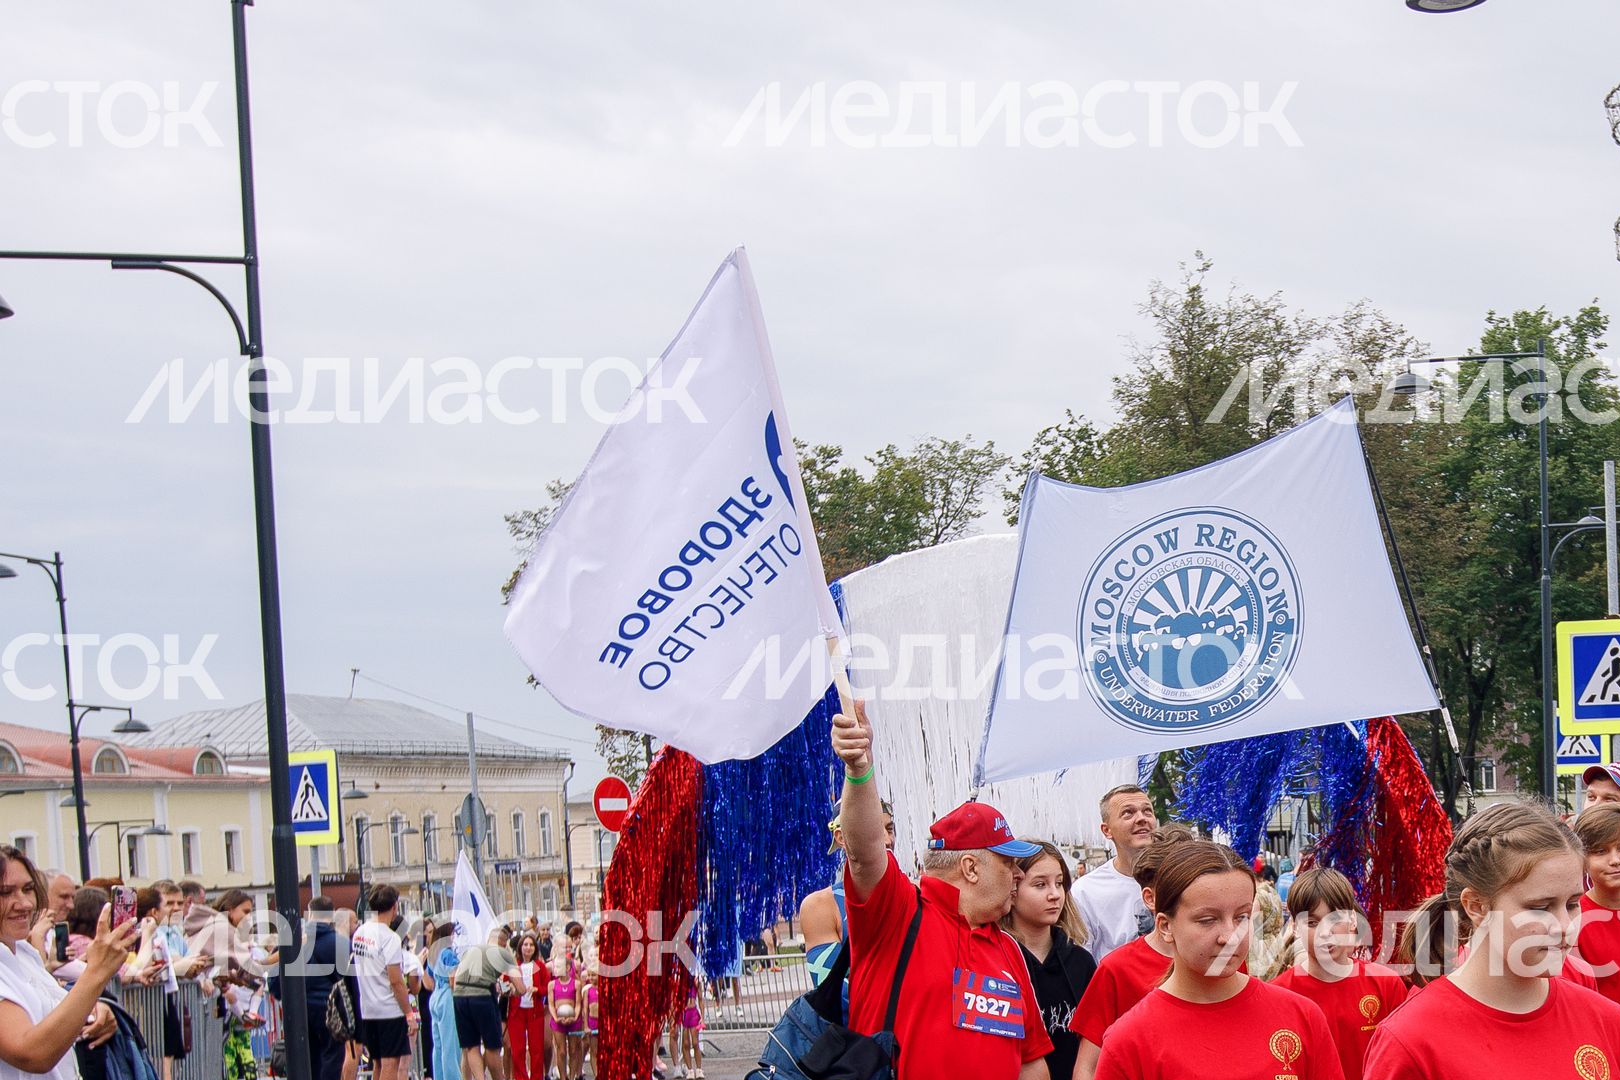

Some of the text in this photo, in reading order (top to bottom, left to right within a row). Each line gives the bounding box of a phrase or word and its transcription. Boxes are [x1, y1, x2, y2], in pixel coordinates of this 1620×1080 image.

[1091, 523, 1289, 650] MOSCOW REGION
[1099, 631, 1286, 723] UNDERWATER FEDERATION
[964, 992, 1011, 1018] 7827
